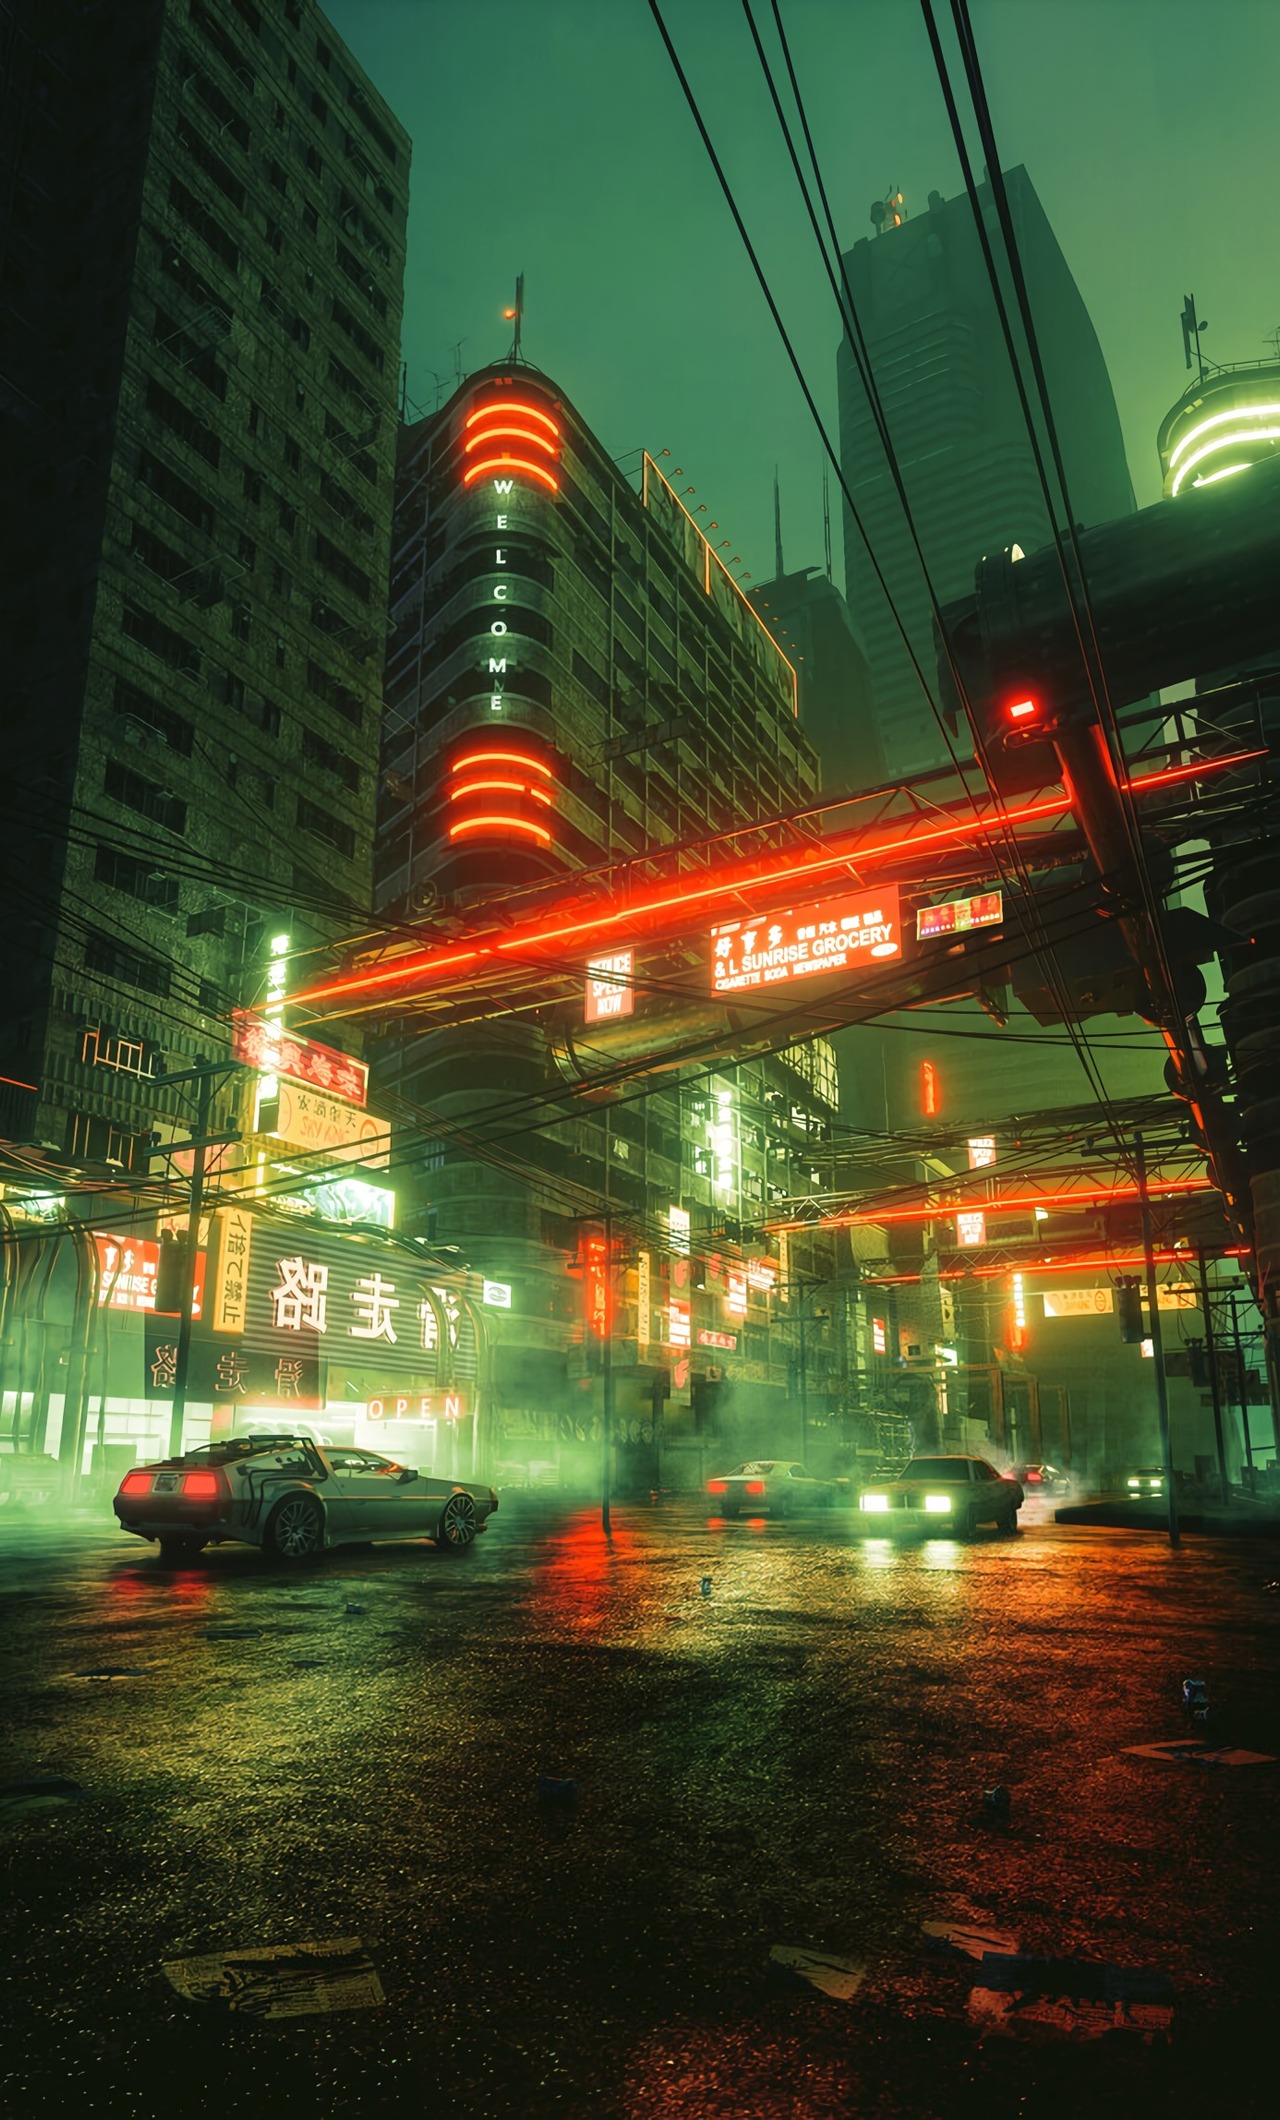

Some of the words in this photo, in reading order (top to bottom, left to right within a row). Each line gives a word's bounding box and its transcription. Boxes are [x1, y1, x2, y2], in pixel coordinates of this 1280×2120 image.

[488, 479, 514, 711] WELCOME
[714, 961, 726, 978] &
[729, 958, 739, 975] L
[742, 943, 809, 972] SUNRISE
[812, 923, 893, 954] GROCERY
[793, 953, 847, 975] NEWSPAPER
[597, 994, 623, 1016] NOW
[368, 1397, 460, 1420] OPEN
